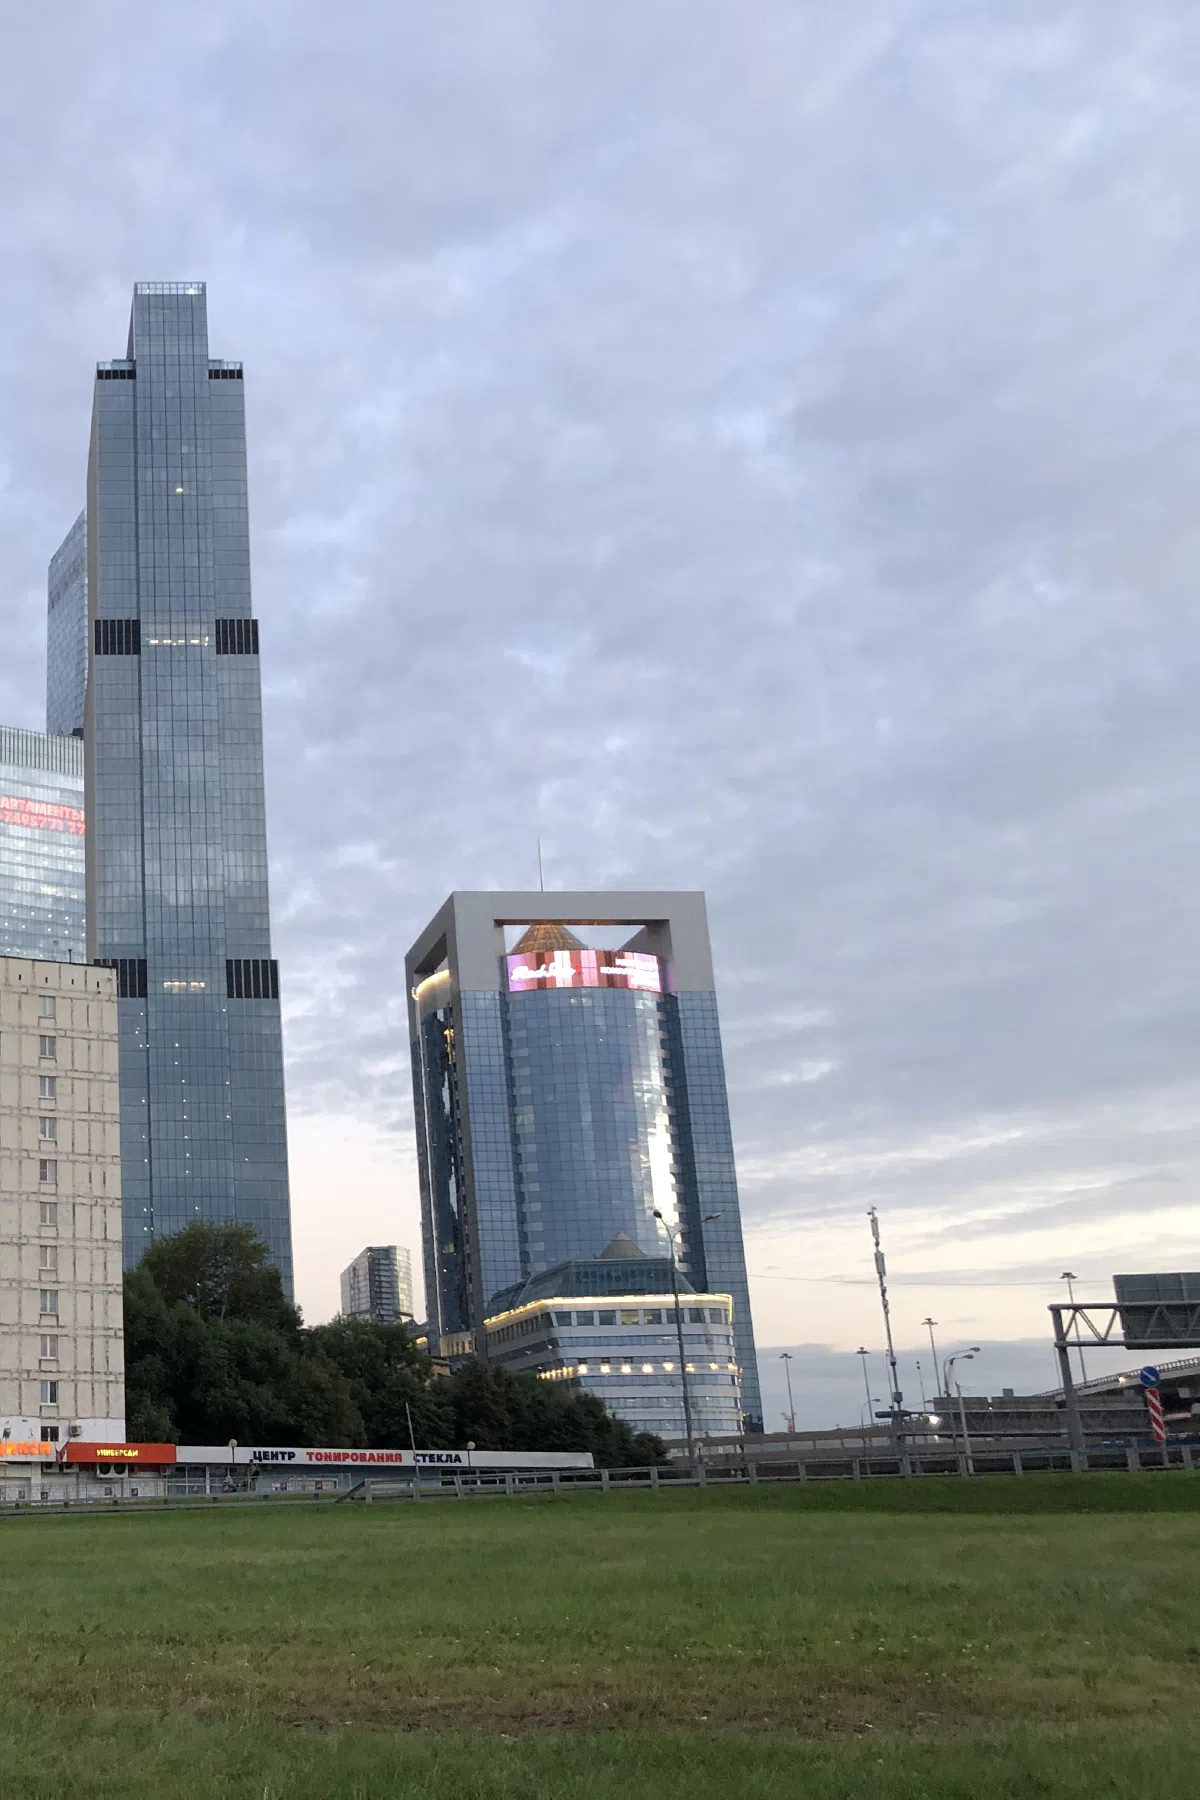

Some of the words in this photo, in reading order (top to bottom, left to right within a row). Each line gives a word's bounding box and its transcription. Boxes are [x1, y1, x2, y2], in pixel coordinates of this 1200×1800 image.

[253, 1450, 296, 1461] ЦЕНТР
[306, 1451, 402, 1463] ТОНИРОВАНИЯ
[413, 1453, 462, 1464] СТЕКЛА
